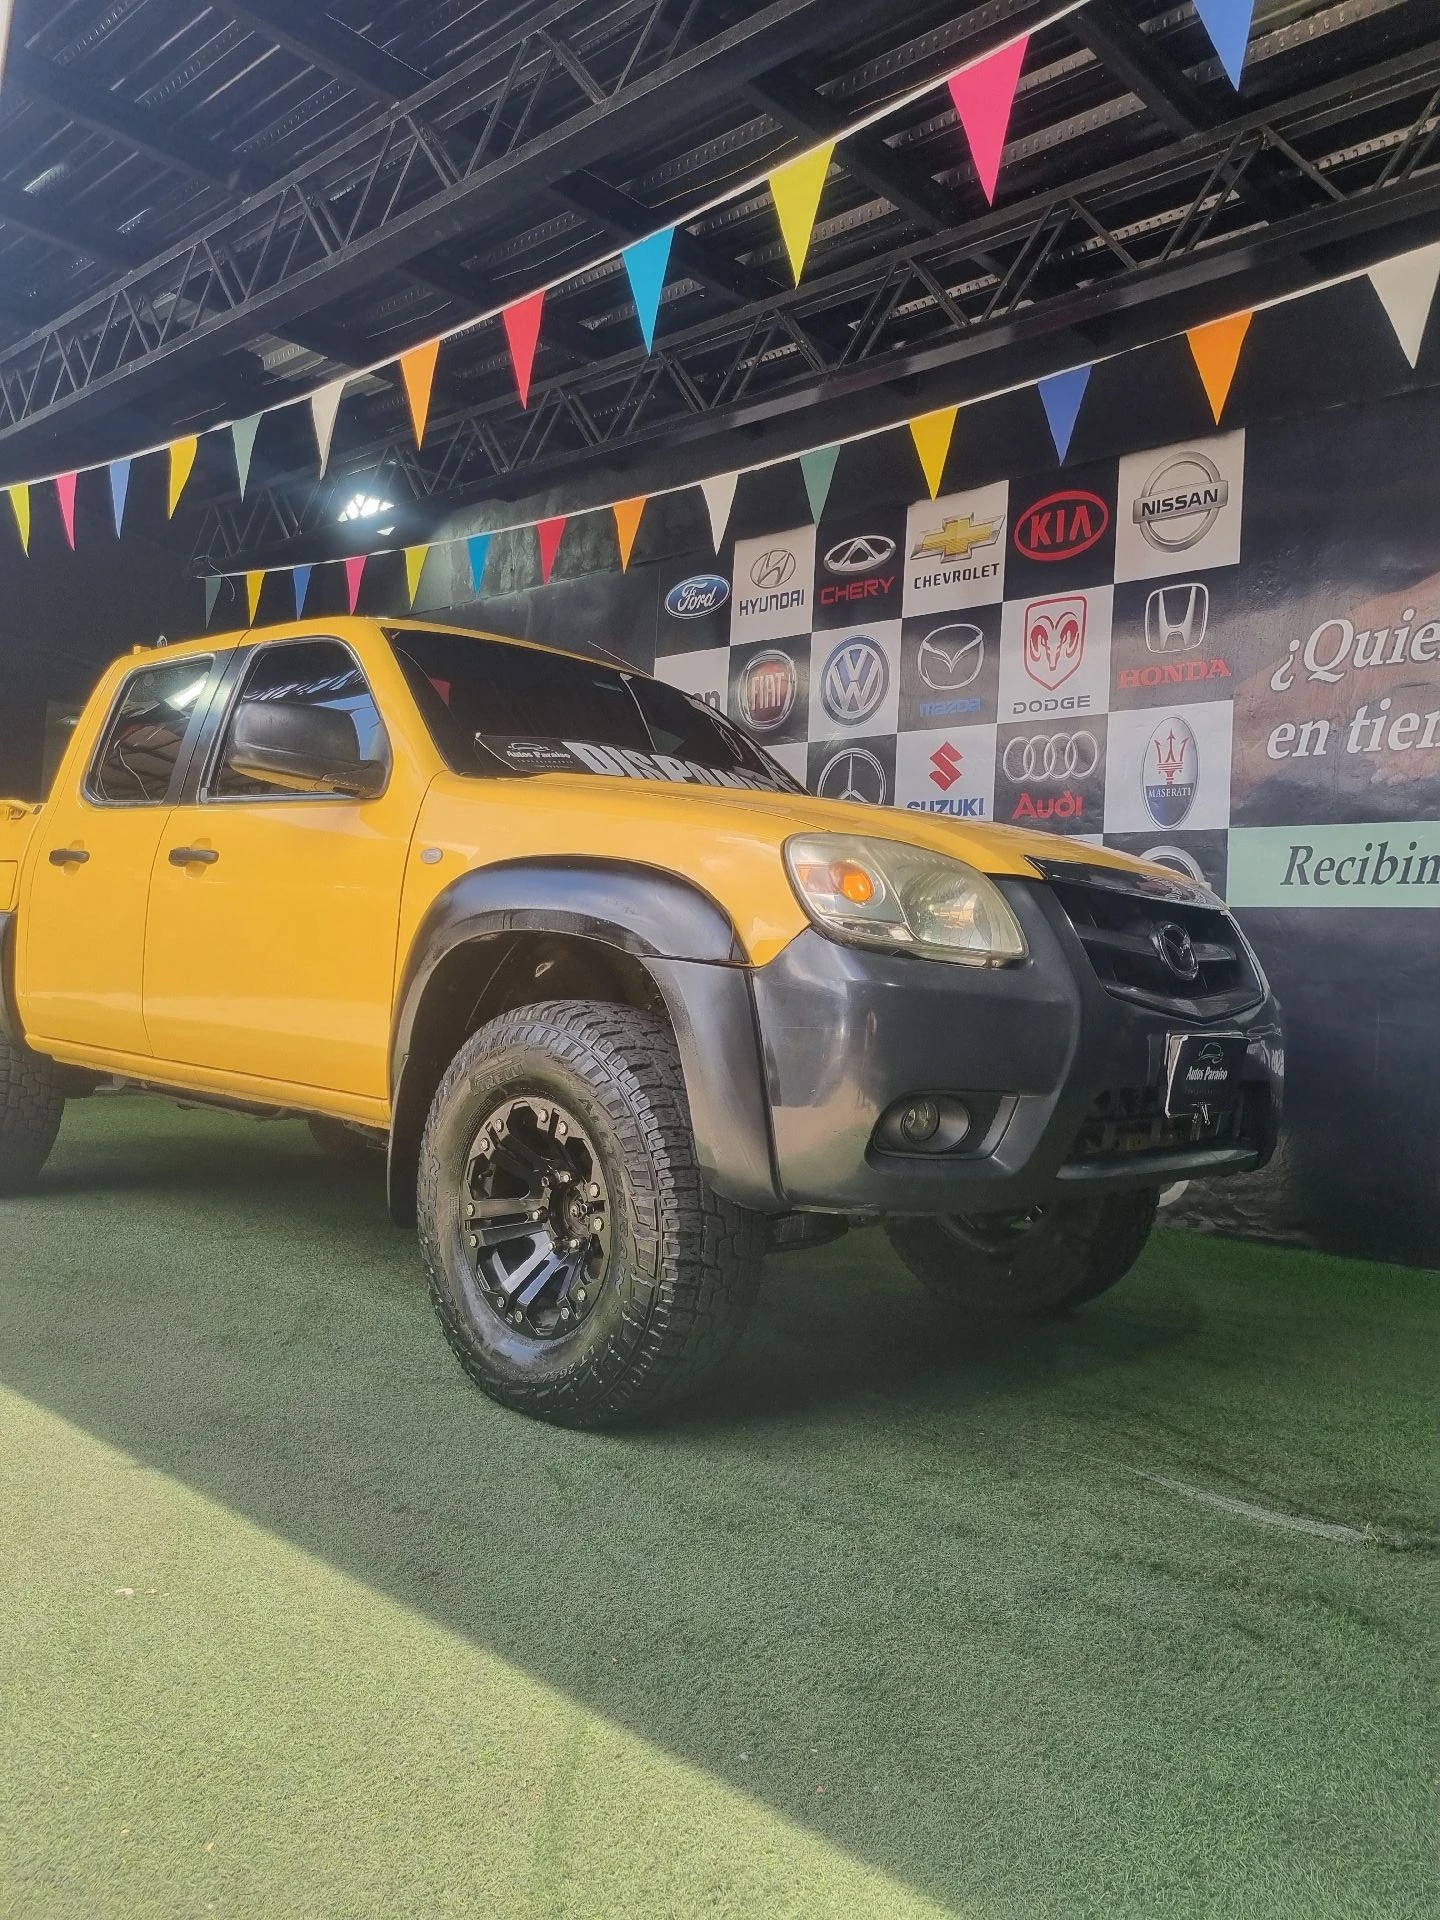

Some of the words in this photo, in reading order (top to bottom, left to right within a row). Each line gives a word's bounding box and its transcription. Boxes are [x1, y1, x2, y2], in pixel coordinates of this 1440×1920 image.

[1142, 488, 1218, 517] NISSAN
[1030, 505, 1092, 548] KIA
[820, 576, 895, 605] CHERY
[914, 563, 1000, 590] CHEVROLET
[677, 582, 717, 611] Ford
[739, 589, 805, 616] HYUNDAI
[1117, 658, 1232, 690] HONDA
[750, 672, 785, 711] FIAT
[1012, 695, 1091, 715] DODGE
[1267, 719, 1330, 759] en
[1147, 786, 1192, 799] MASERATI
[1185, 1065, 1204, 1081] Autos
